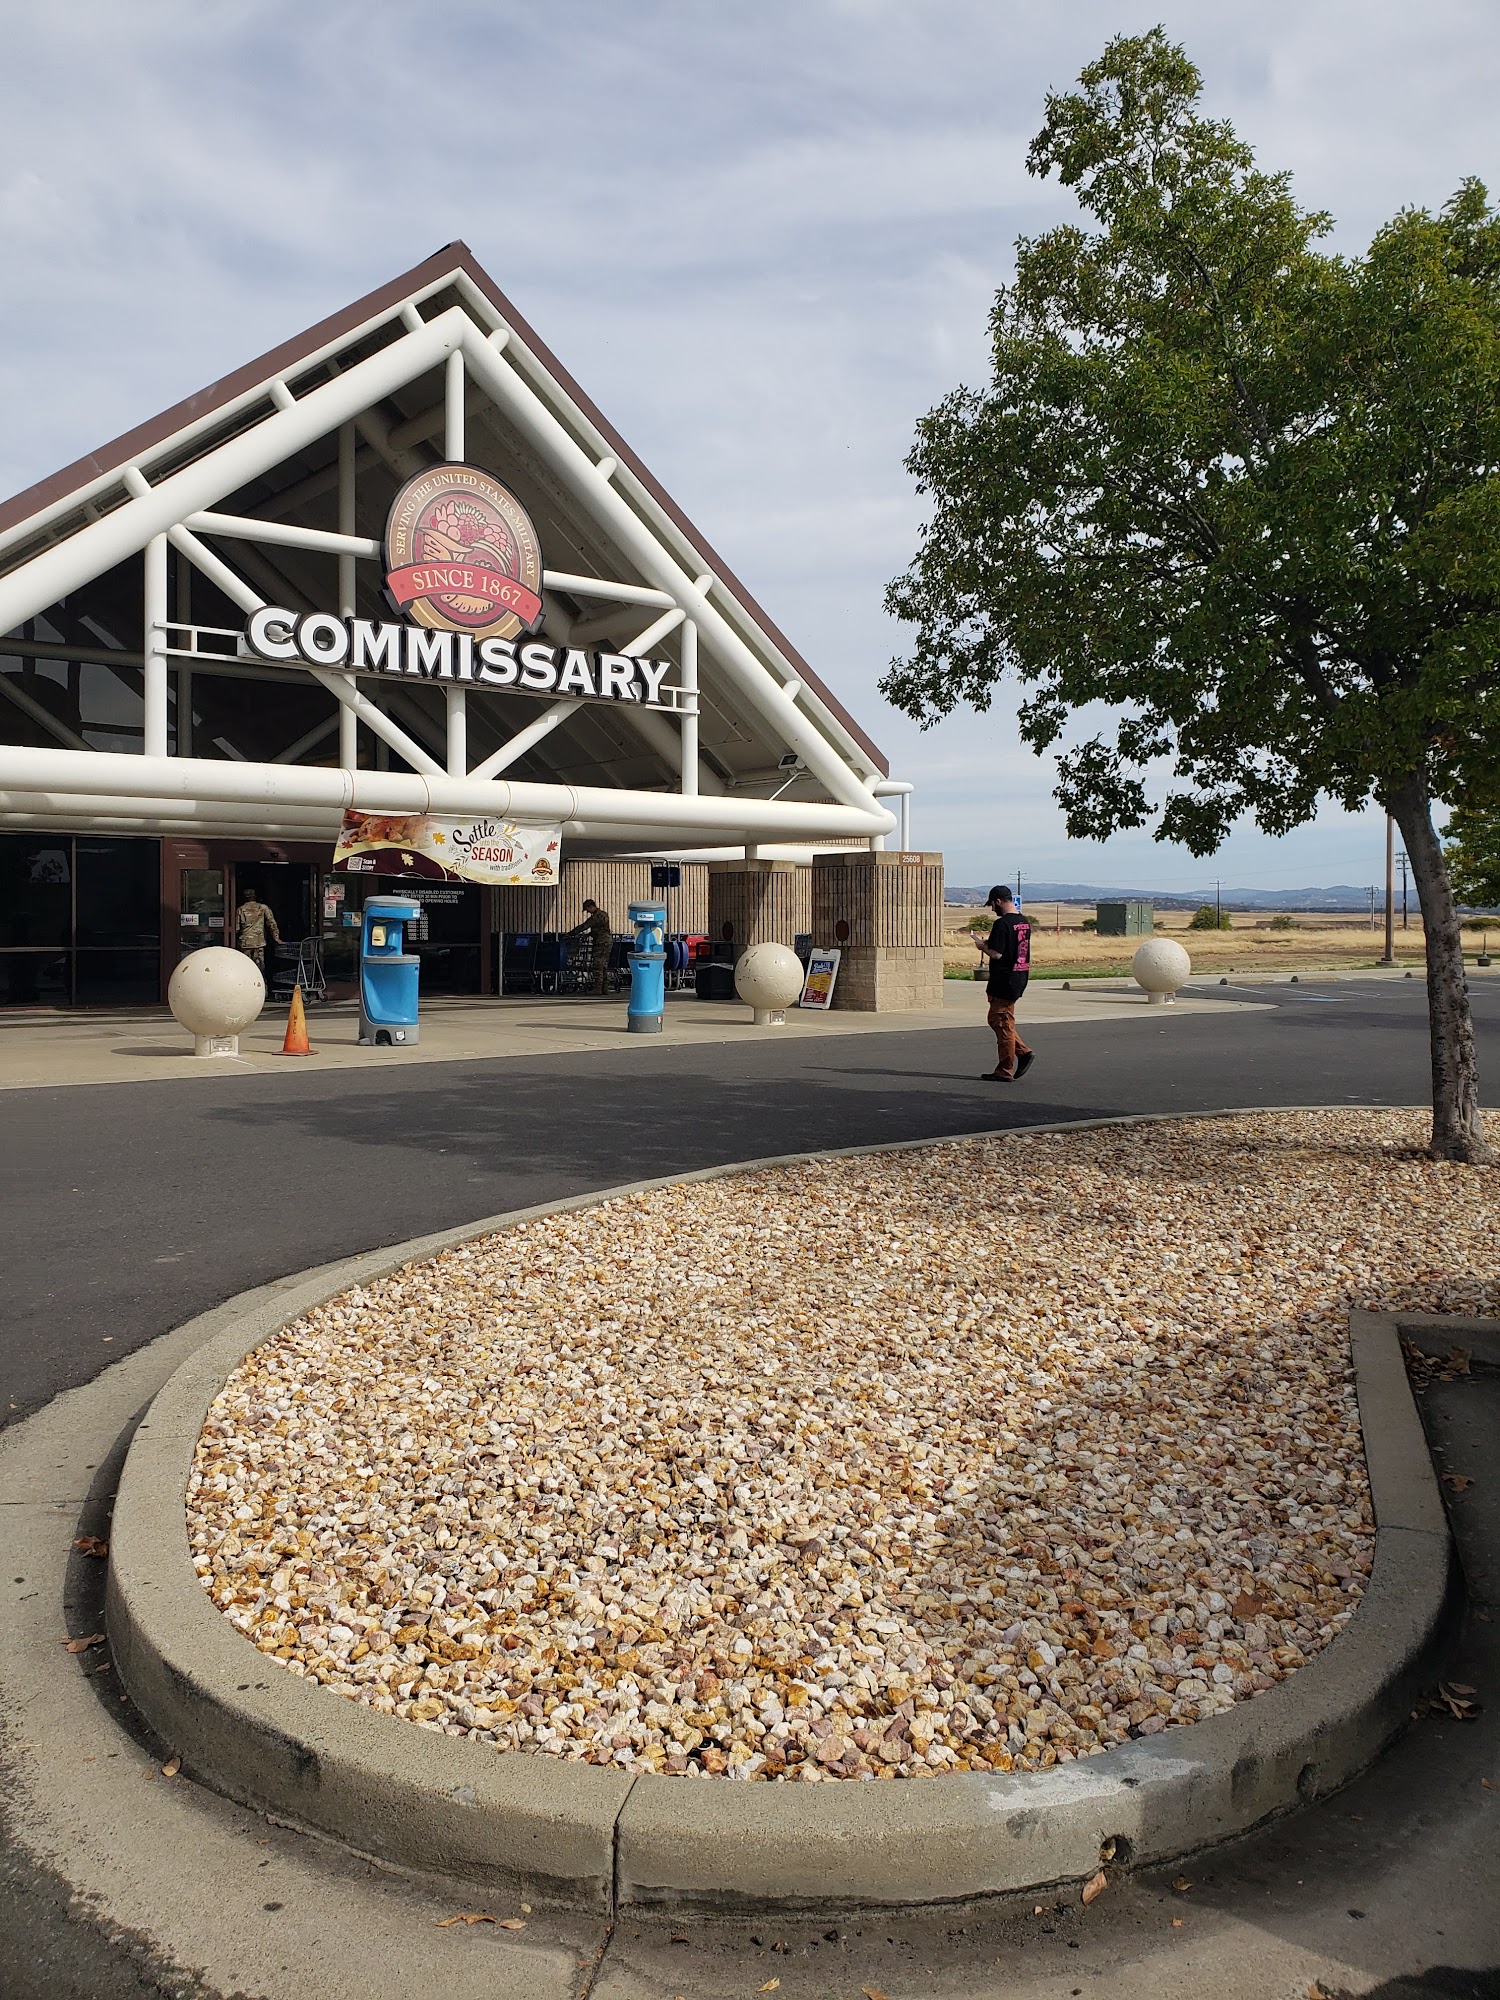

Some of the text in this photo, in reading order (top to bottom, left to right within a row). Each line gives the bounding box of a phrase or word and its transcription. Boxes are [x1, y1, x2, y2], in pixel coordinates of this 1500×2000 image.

[396, 473, 535, 578] SERVING THE UNITED STATES MILITARY
[412, 569, 522, 606] SINCE 1867
[247, 605, 671, 704] COMMISSARY
[452, 819, 497, 853] Settle
[471, 846, 514, 863] SEASON
[489, 864, 501, 872] with
[501, 857, 523, 872] traditions
